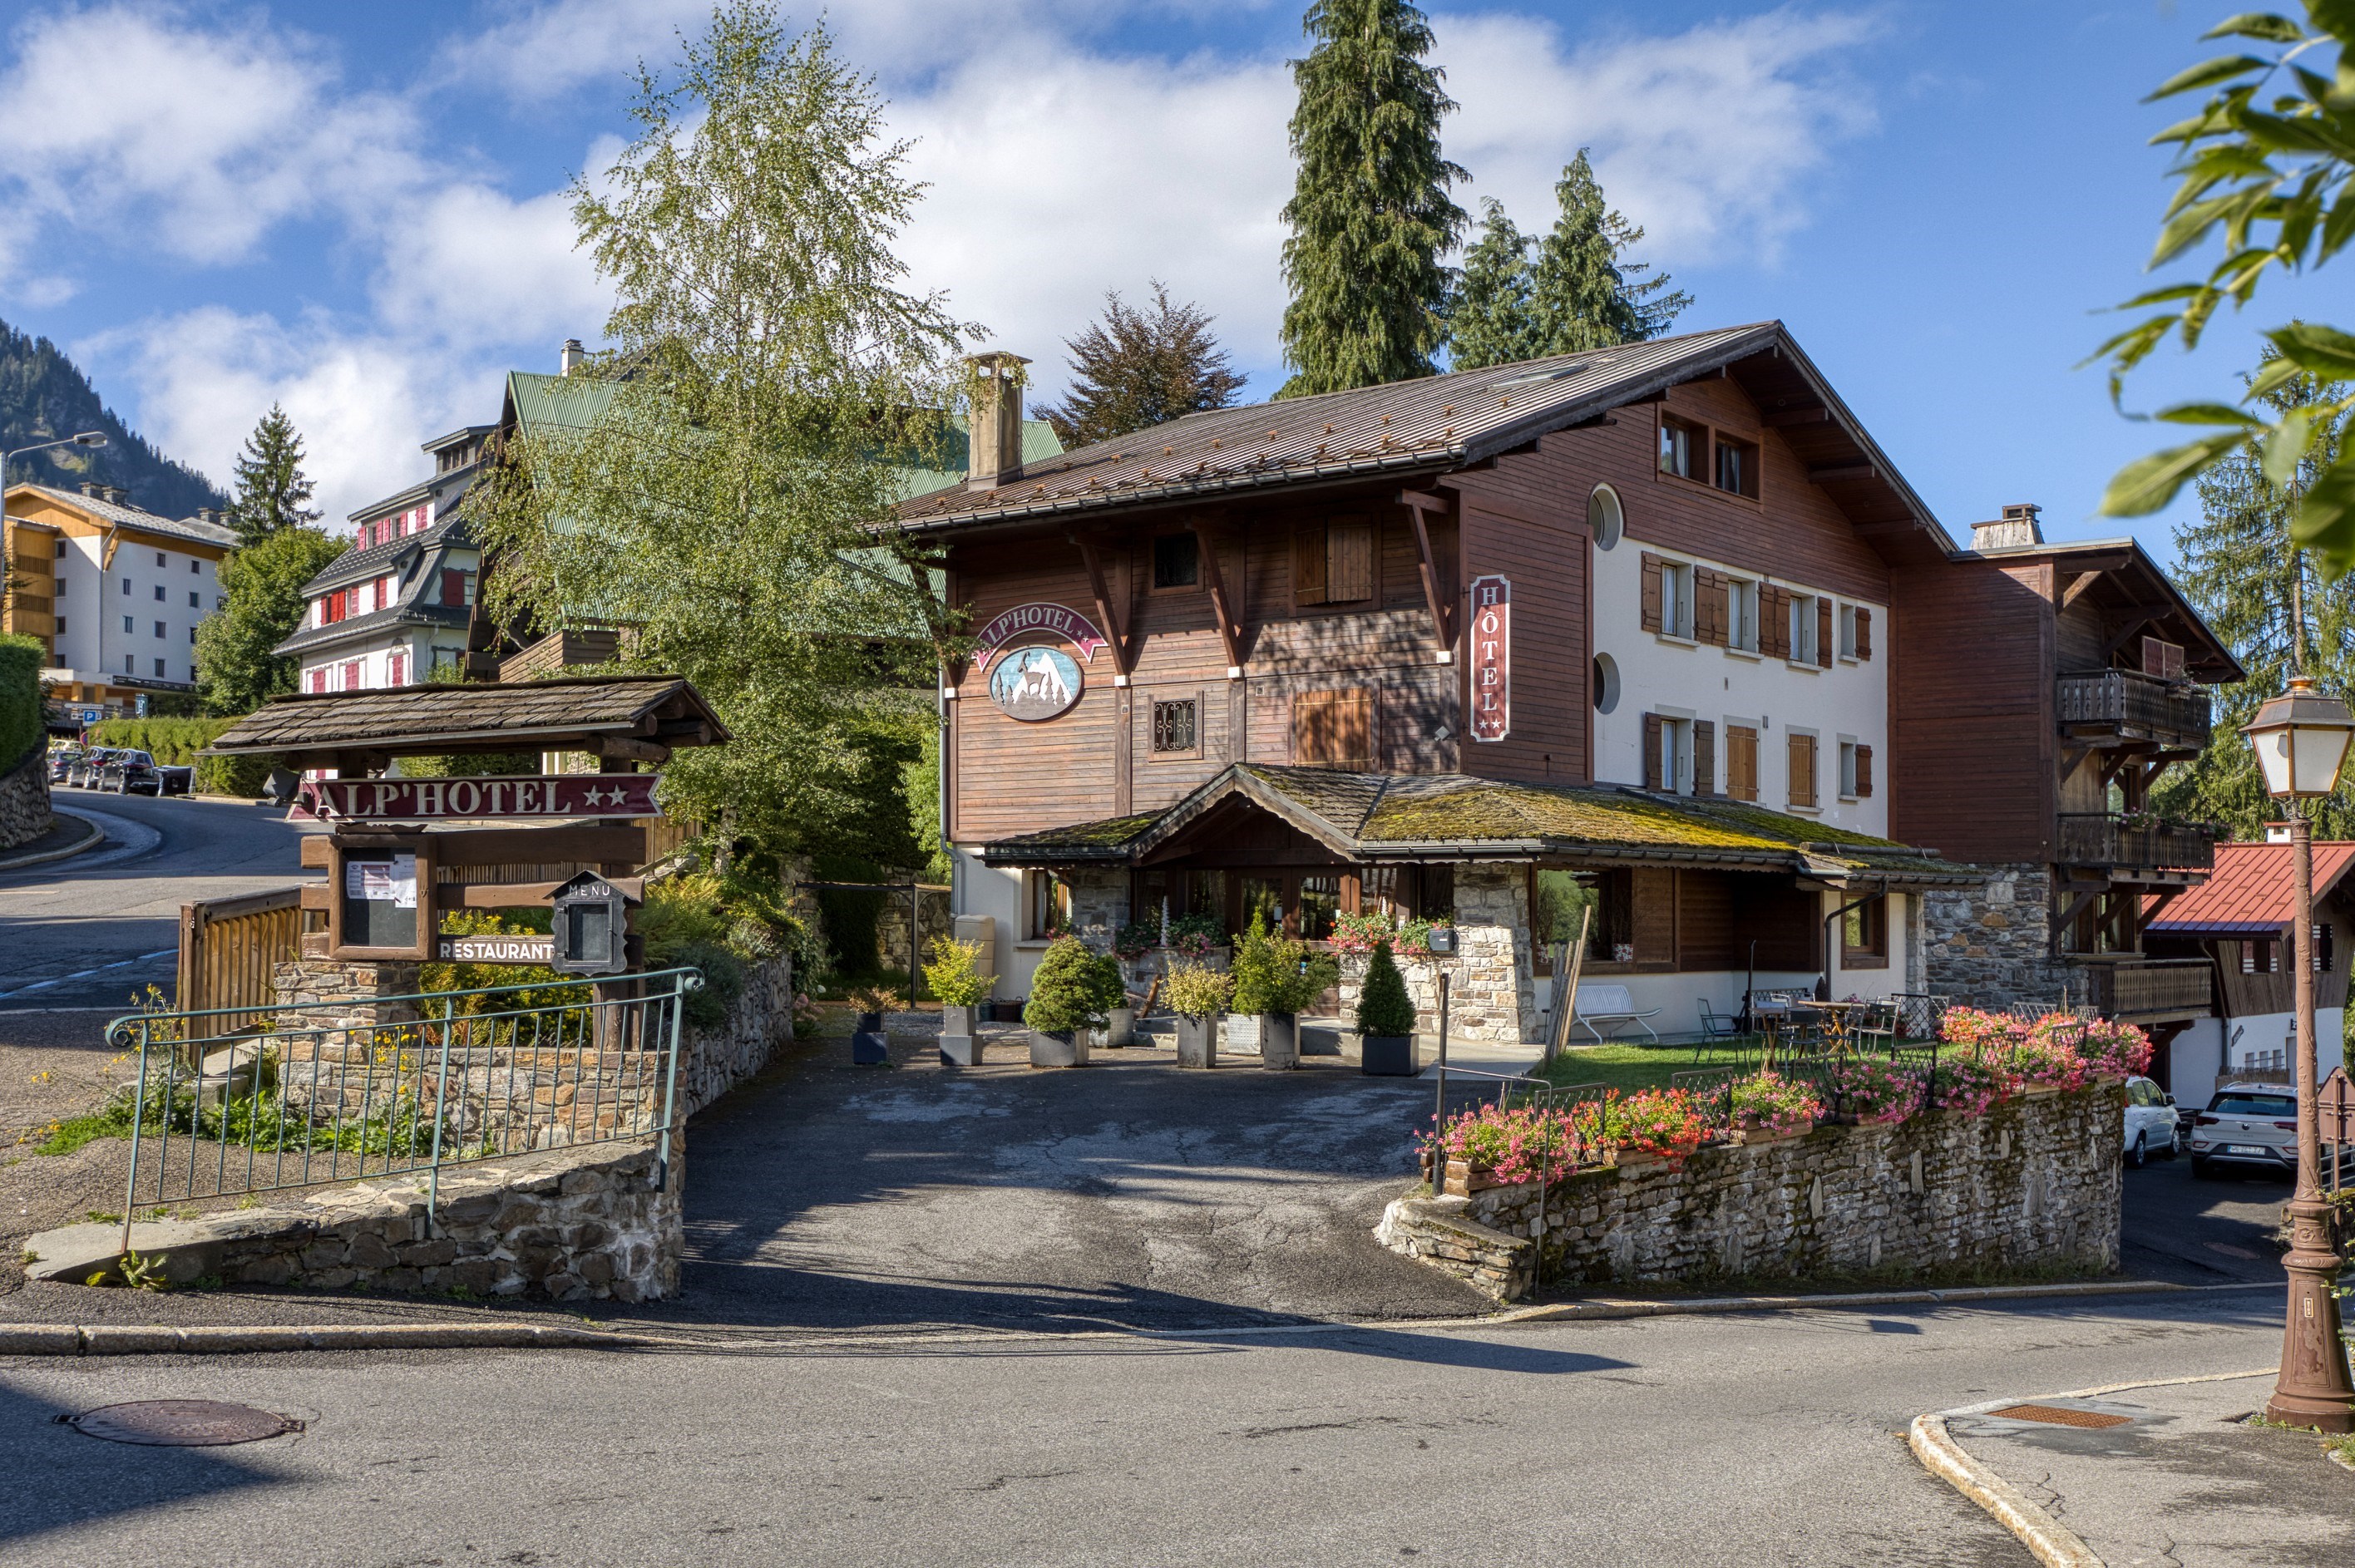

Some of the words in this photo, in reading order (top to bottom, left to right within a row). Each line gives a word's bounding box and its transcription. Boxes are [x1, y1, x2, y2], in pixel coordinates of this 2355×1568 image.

[982, 607, 1074, 655] LP'HOTEL
[1481, 587, 1498, 711] HÔTEL
[86, 713, 93, 721] P
[316, 781, 571, 817] ALP'HOTEL
[569, 885, 610, 896] MENU
[440, 943, 555, 959] RESTAURANT
